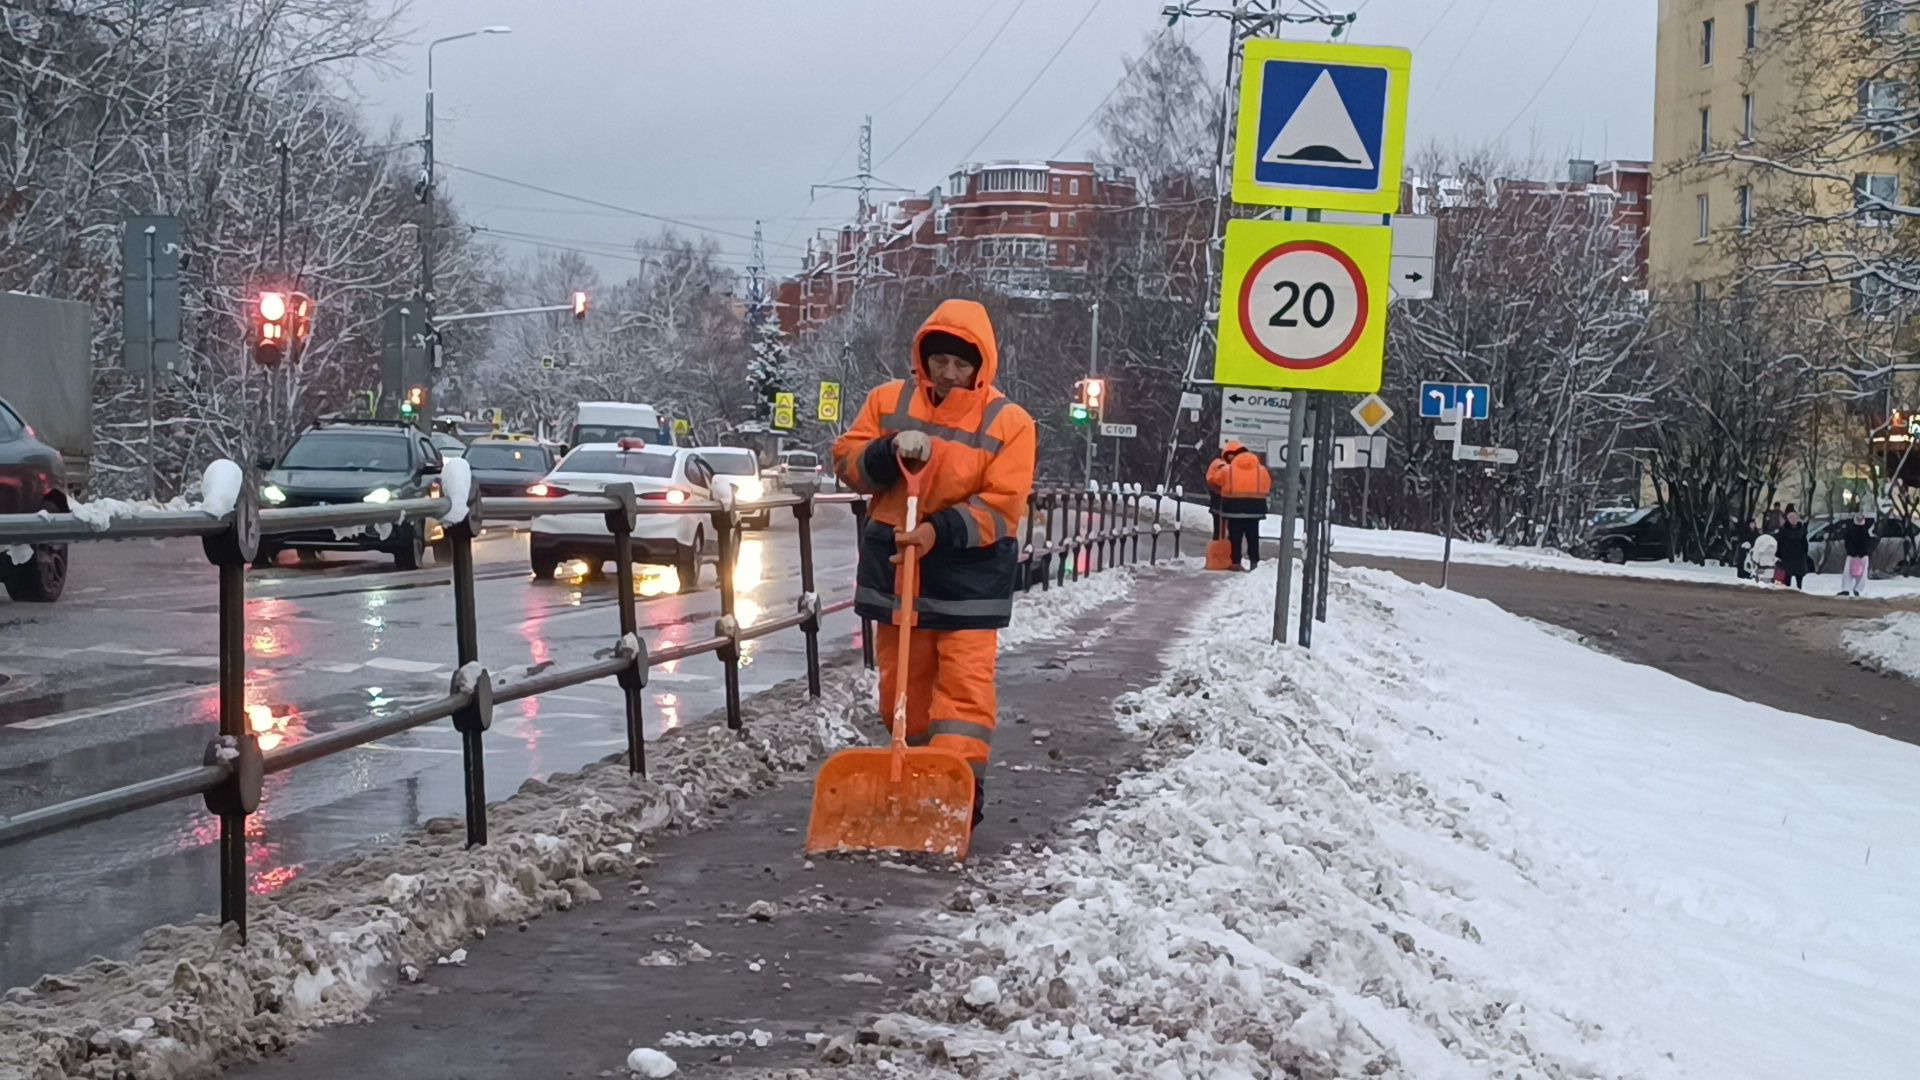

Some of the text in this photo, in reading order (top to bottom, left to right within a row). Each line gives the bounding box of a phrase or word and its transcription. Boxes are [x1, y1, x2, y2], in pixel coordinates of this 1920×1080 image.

[1268, 280, 1335, 329] 20
[1247, 395, 1291, 409] ОГИБД
[1105, 425, 1132, 435] СТОП
[1279, 443, 1344, 462] СТП
